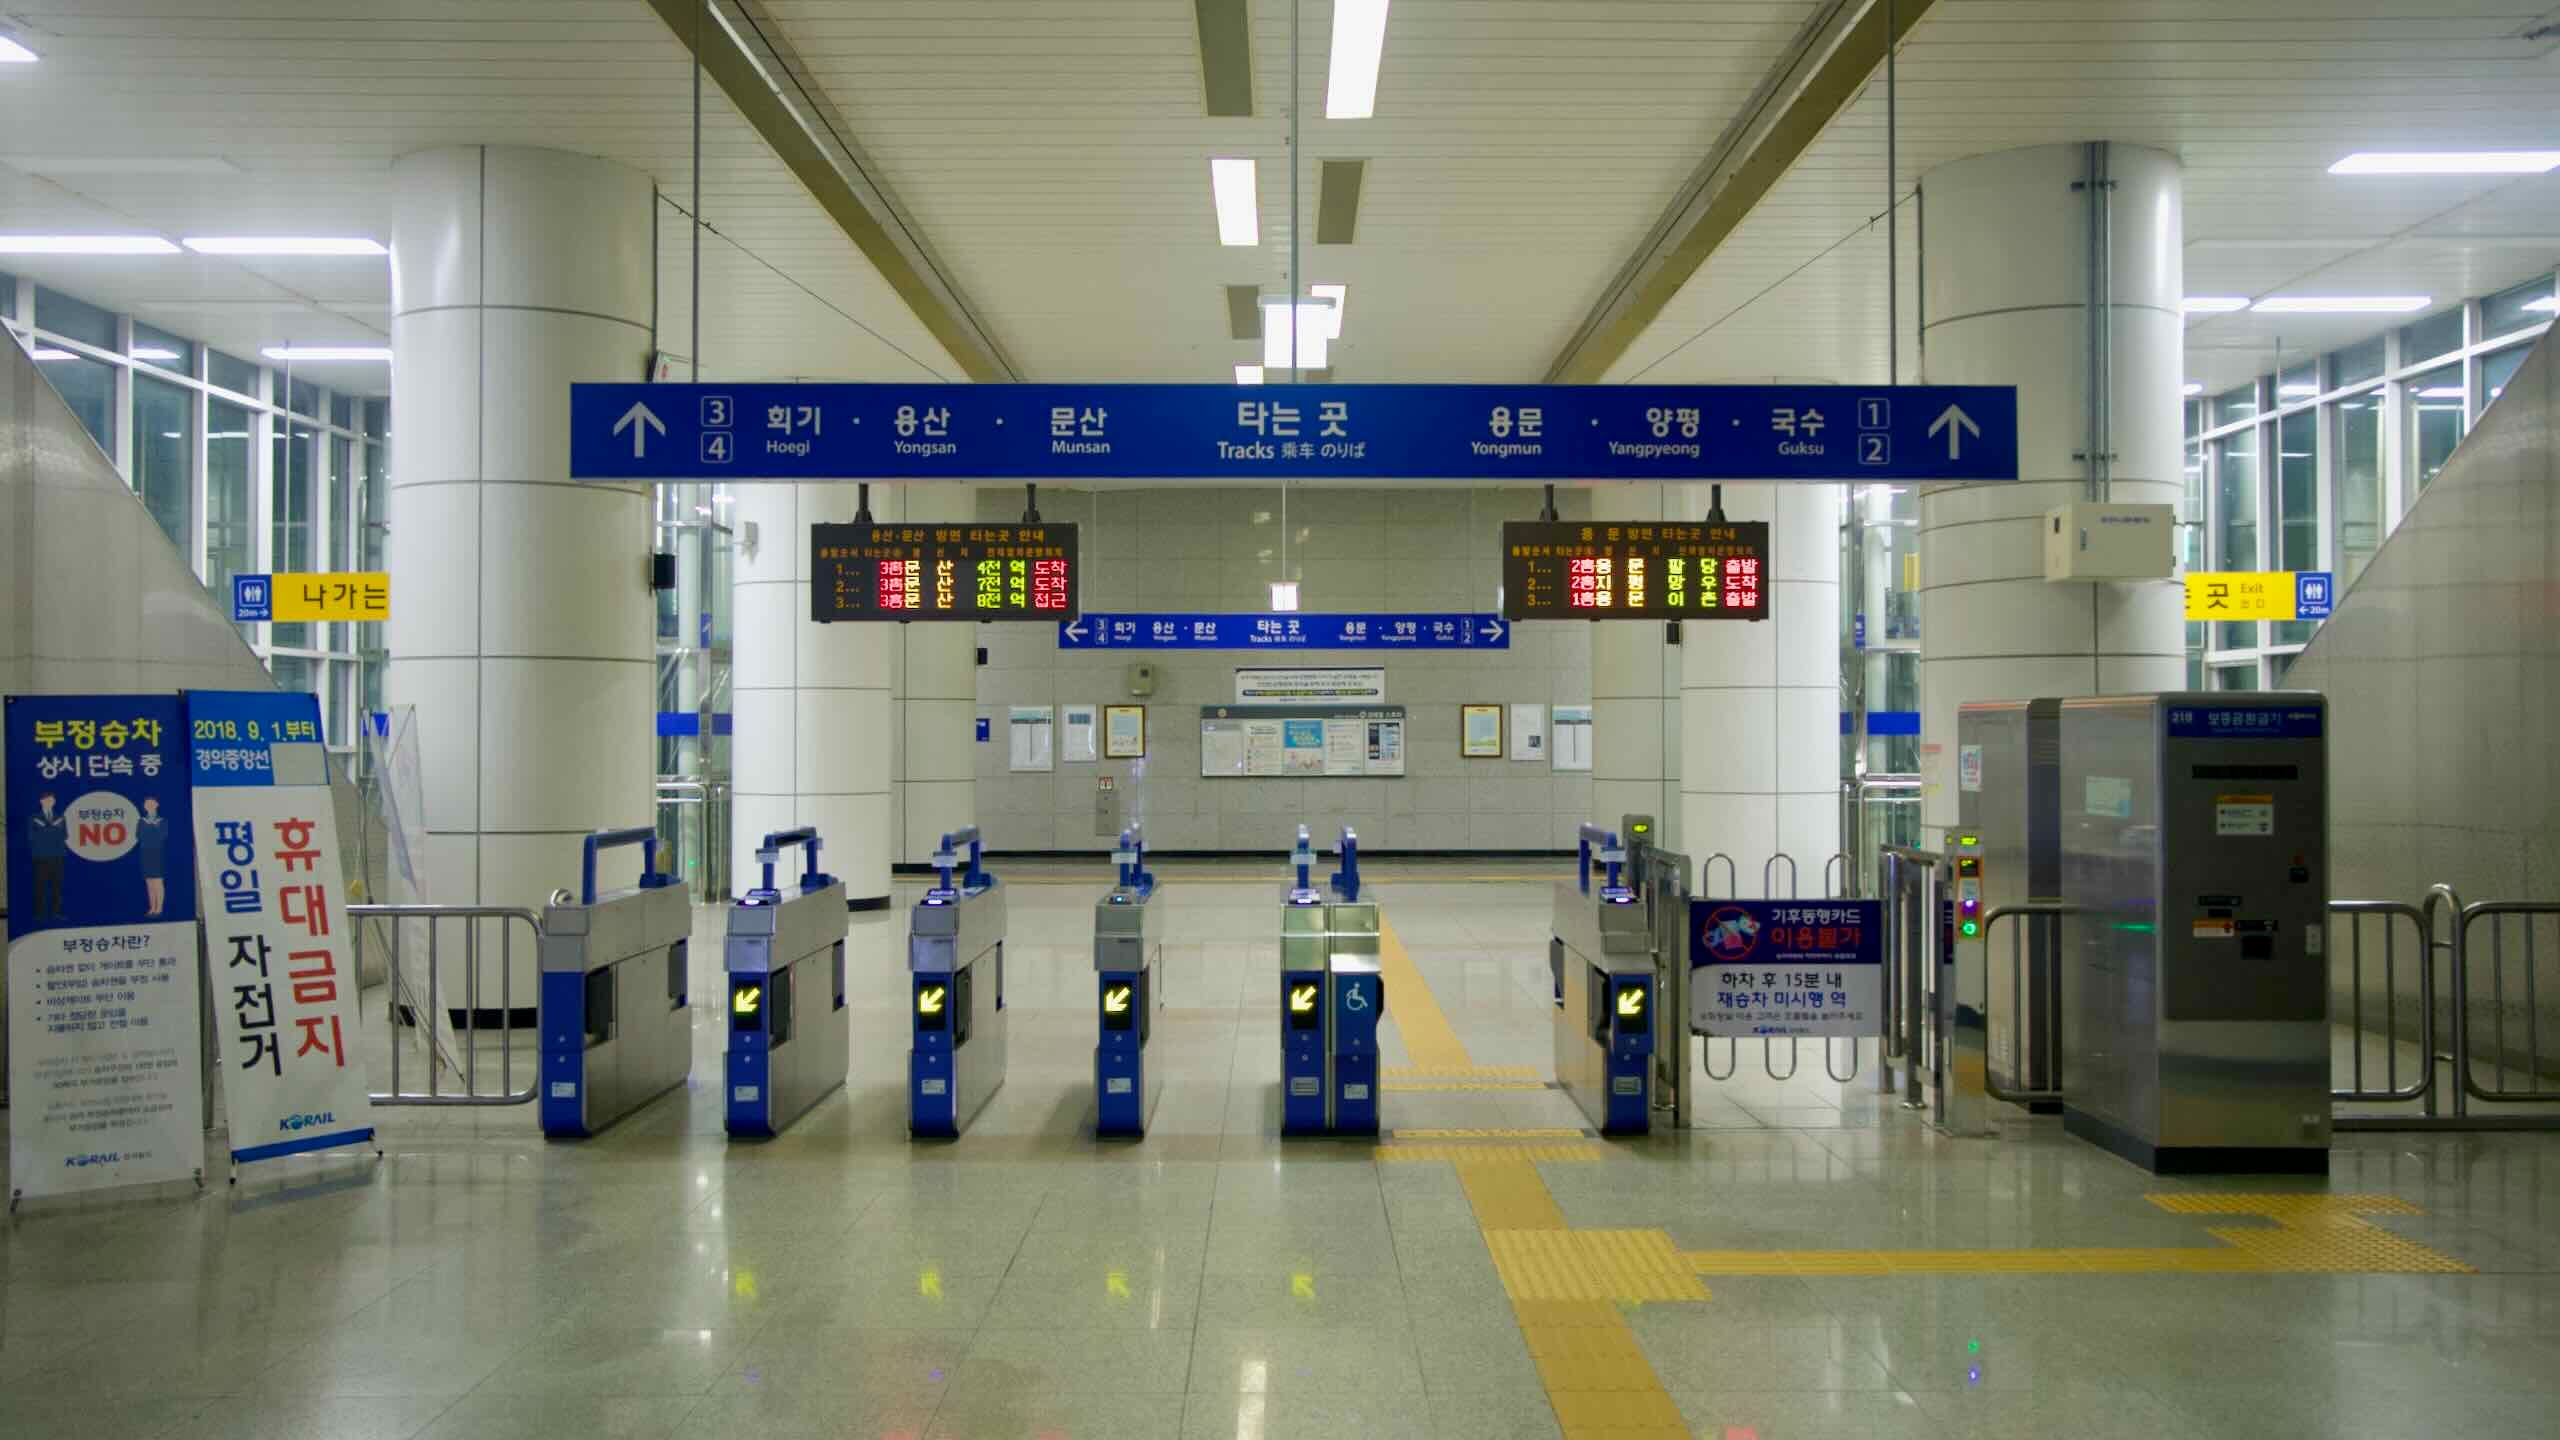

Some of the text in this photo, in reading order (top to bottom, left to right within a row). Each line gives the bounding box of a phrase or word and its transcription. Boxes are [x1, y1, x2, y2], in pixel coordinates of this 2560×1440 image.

[709, 400, 724, 424] 3
[1237, 401, 1348, 436] 타는 곳
[1867, 404, 1881, 425] 1
[767, 406, 1107, 437] 회기 용산 문산
[1489, 407, 1824, 438] 용문 양평 국수
[708, 437, 726, 459] 4
[766, 440, 1111, 455] Hoegi Yongsan Munsan
[1217, 441, 1274, 459] Tracks
[1321, 442, 1365, 459] のりば
[1471, 441, 1824, 459] Yongmun Yangpyeong Guksu
[1866, 439, 1883, 461] 2
[1034, 561, 1066, 575] 도착
[1726, 559, 1758, 574] 출발
[1034, 578, 1066, 592] 도착
[1726, 576, 1758, 590] 도착
[2240, 584, 2264, 594] Exit
[303, 584, 386, 610] 나가는
[1034, 594, 1066, 608] 접근
[1726, 592, 1758, 607] 출발
[2207, 583, 2229, 609] 곳
[1153, 622, 1175, 634] 용산
[1194, 622, 1216, 634] 문산
[1257, 620, 1299, 634] 타는 곳
[1346, 622, 1366, 634] 용문
[1433, 622, 1454, 634] 국수
[1463, 633, 1471, 643] 2
[34, 718, 162, 748] 부정승차
[194, 719, 316, 742] 2018. 9. 1.부터
[37, 754, 162, 779] 상시 단속 중
[195, 749, 270, 771] 경의중앙선
[78, 808, 125, 820] 부정승차
[78, 823, 127, 848] NO
[1772, 909, 1861, 925] 기후동행카드
[63, 935, 150, 952] 부정승차란?
[273, 815, 345, 1069] 휴대금지
[1771, 927, 1862, 949] 이용불가
[214, 820, 283, 1078] 평일 자전거
[1722, 973, 1842, 989] 하차 후 15분 내
[1717, 992, 1846, 1008] 재승차 미시행 역
